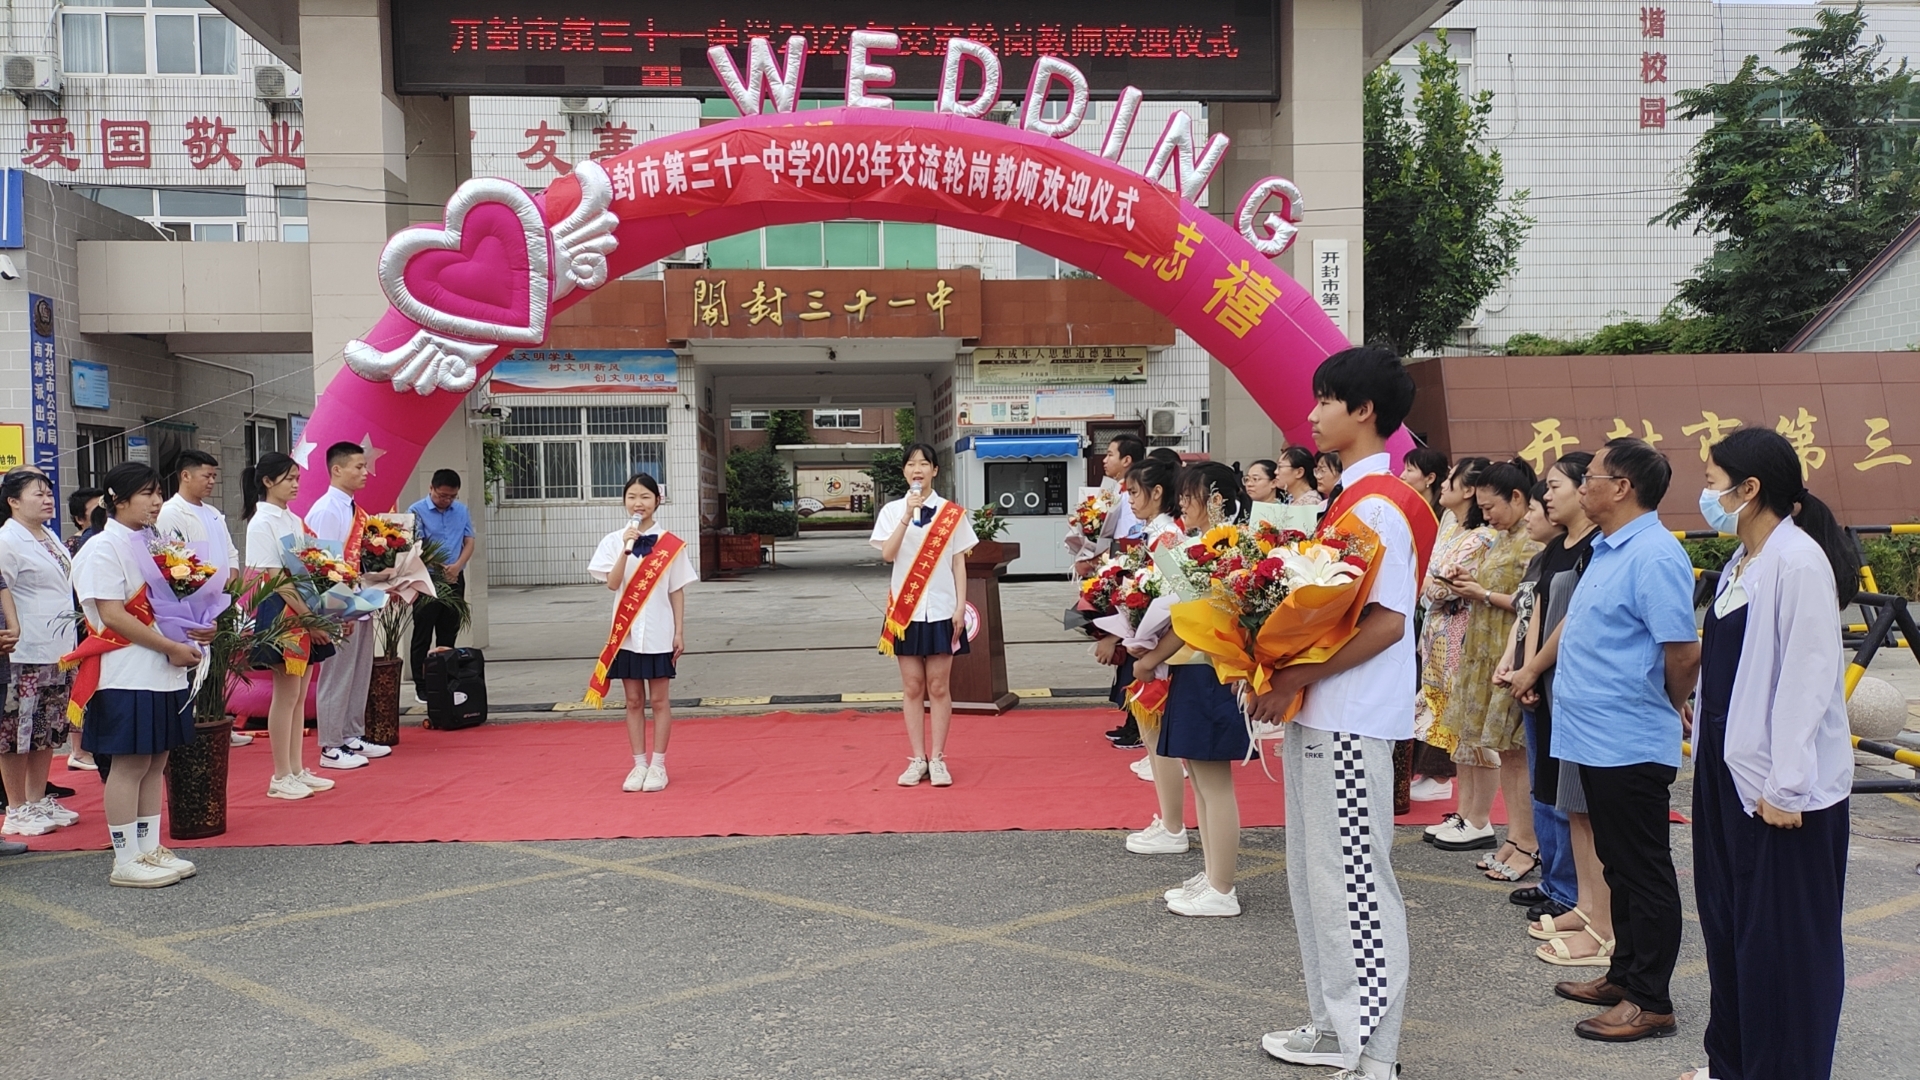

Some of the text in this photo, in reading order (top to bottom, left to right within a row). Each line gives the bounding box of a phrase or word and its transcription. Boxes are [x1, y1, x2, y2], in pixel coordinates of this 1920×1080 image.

[450, 17, 1239, 58] 开封市第三十一中学2023交流轮岗教师欢迎仪式
[1640, 7, 1667, 128] 谐校园
[21, 116, 305, 171] 爱国敬业
[607, 139, 1139, 231] 封市第三十一中学2023年交流轮岗教师欢迎仪式
[707, 30, 1304, 257] WEDDING
[1124, 222, 1282, 339] 志禧
[34, 342, 46, 444] 南郊派出所
[44, 343, 57, 445] 开封市公安局
[548, 363, 620, 372] 树文明新风
[594, 373, 665, 382] 创文明校园
[995, 348, 1126, 359] 未成年人思想道德建设
[610, 549, 669, 645] 开封市第三十一中学
[903, 507, 959, 605] 开封市第三十一中学
